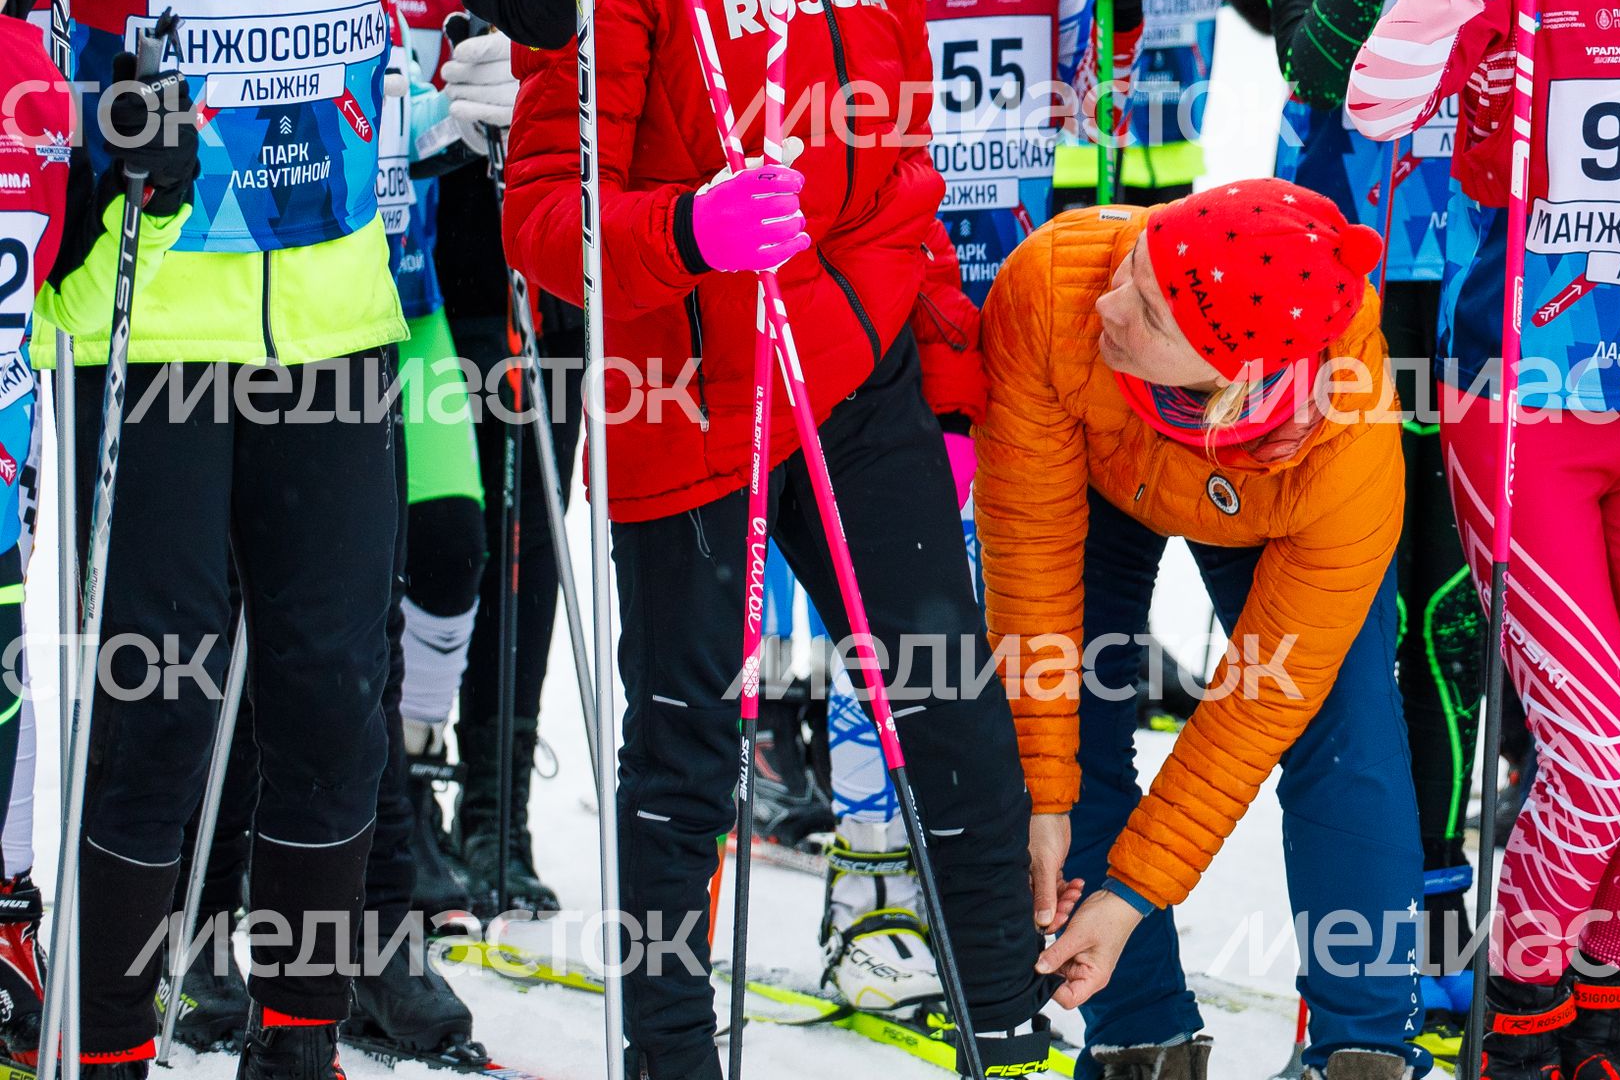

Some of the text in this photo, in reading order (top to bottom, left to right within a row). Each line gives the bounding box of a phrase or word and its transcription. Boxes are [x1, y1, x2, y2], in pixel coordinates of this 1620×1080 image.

[135, 11, 385, 64] АНЖОСОВСКАЯ
[241, 73, 320, 101] ЛЫЖНЯ
[940, 38, 1025, 113] 55
[262, 143, 309, 165] ПАРК
[231, 156, 331, 189] ЛАЗУТИНОЙ
